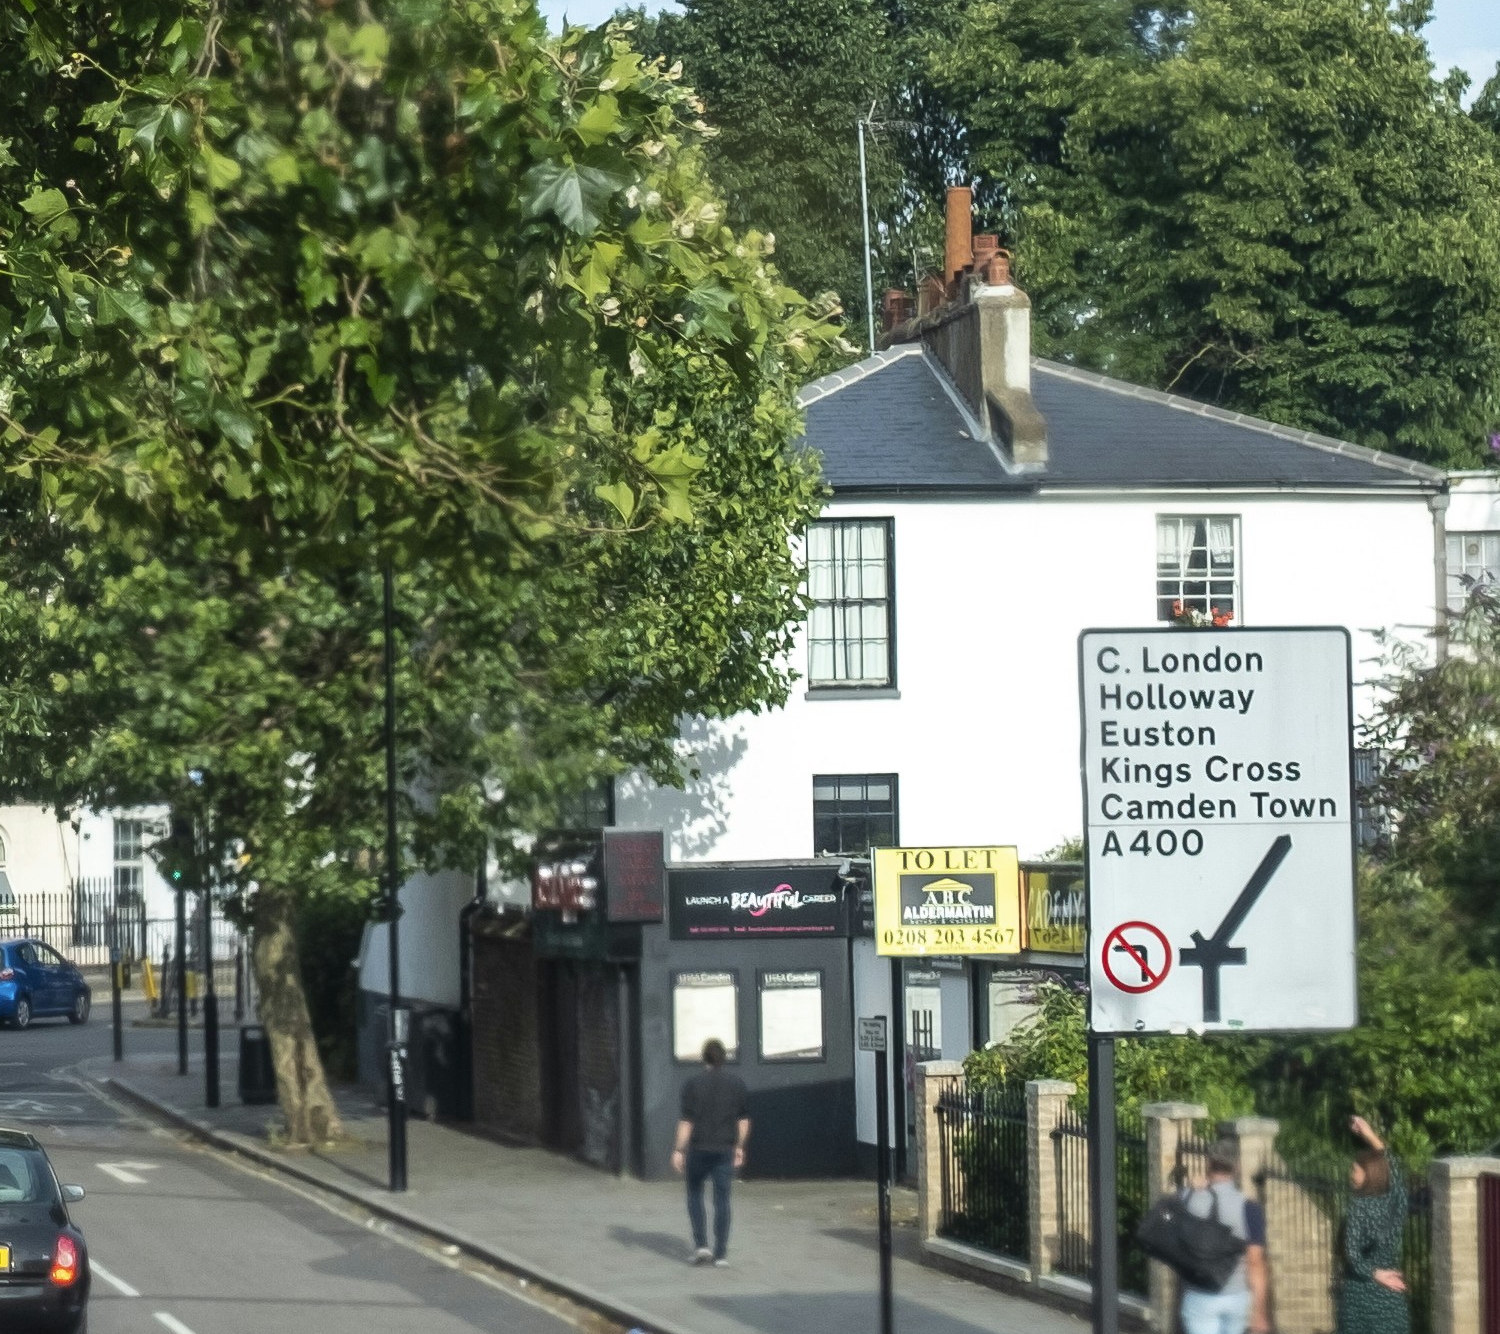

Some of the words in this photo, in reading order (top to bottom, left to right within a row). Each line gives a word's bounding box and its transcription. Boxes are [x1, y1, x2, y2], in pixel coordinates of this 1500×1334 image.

[1096, 646, 1131, 674] C.
[1142, 646, 1263, 674] London
[1100, 683, 1255, 714] Holloway
[1101, 720, 1216, 747] Euston
[1101, 757, 1192, 788] Kings
[1205, 755, 1301, 783] Cross
[1101, 793, 1237, 820] Camden
[1249, 792, 1337, 818] Town
[1101, 829, 1205, 857] A400
[896, 850, 935, 870] TO
[944, 849, 997, 869] LET
[730, 891, 804, 911] BEAUTIFUL
[903, 905, 994, 919] ALDERMARTIN
[884, 929, 927, 945] 0208
[935, 928, 965, 945] 203
[971, 928, 1014, 945] 4567
